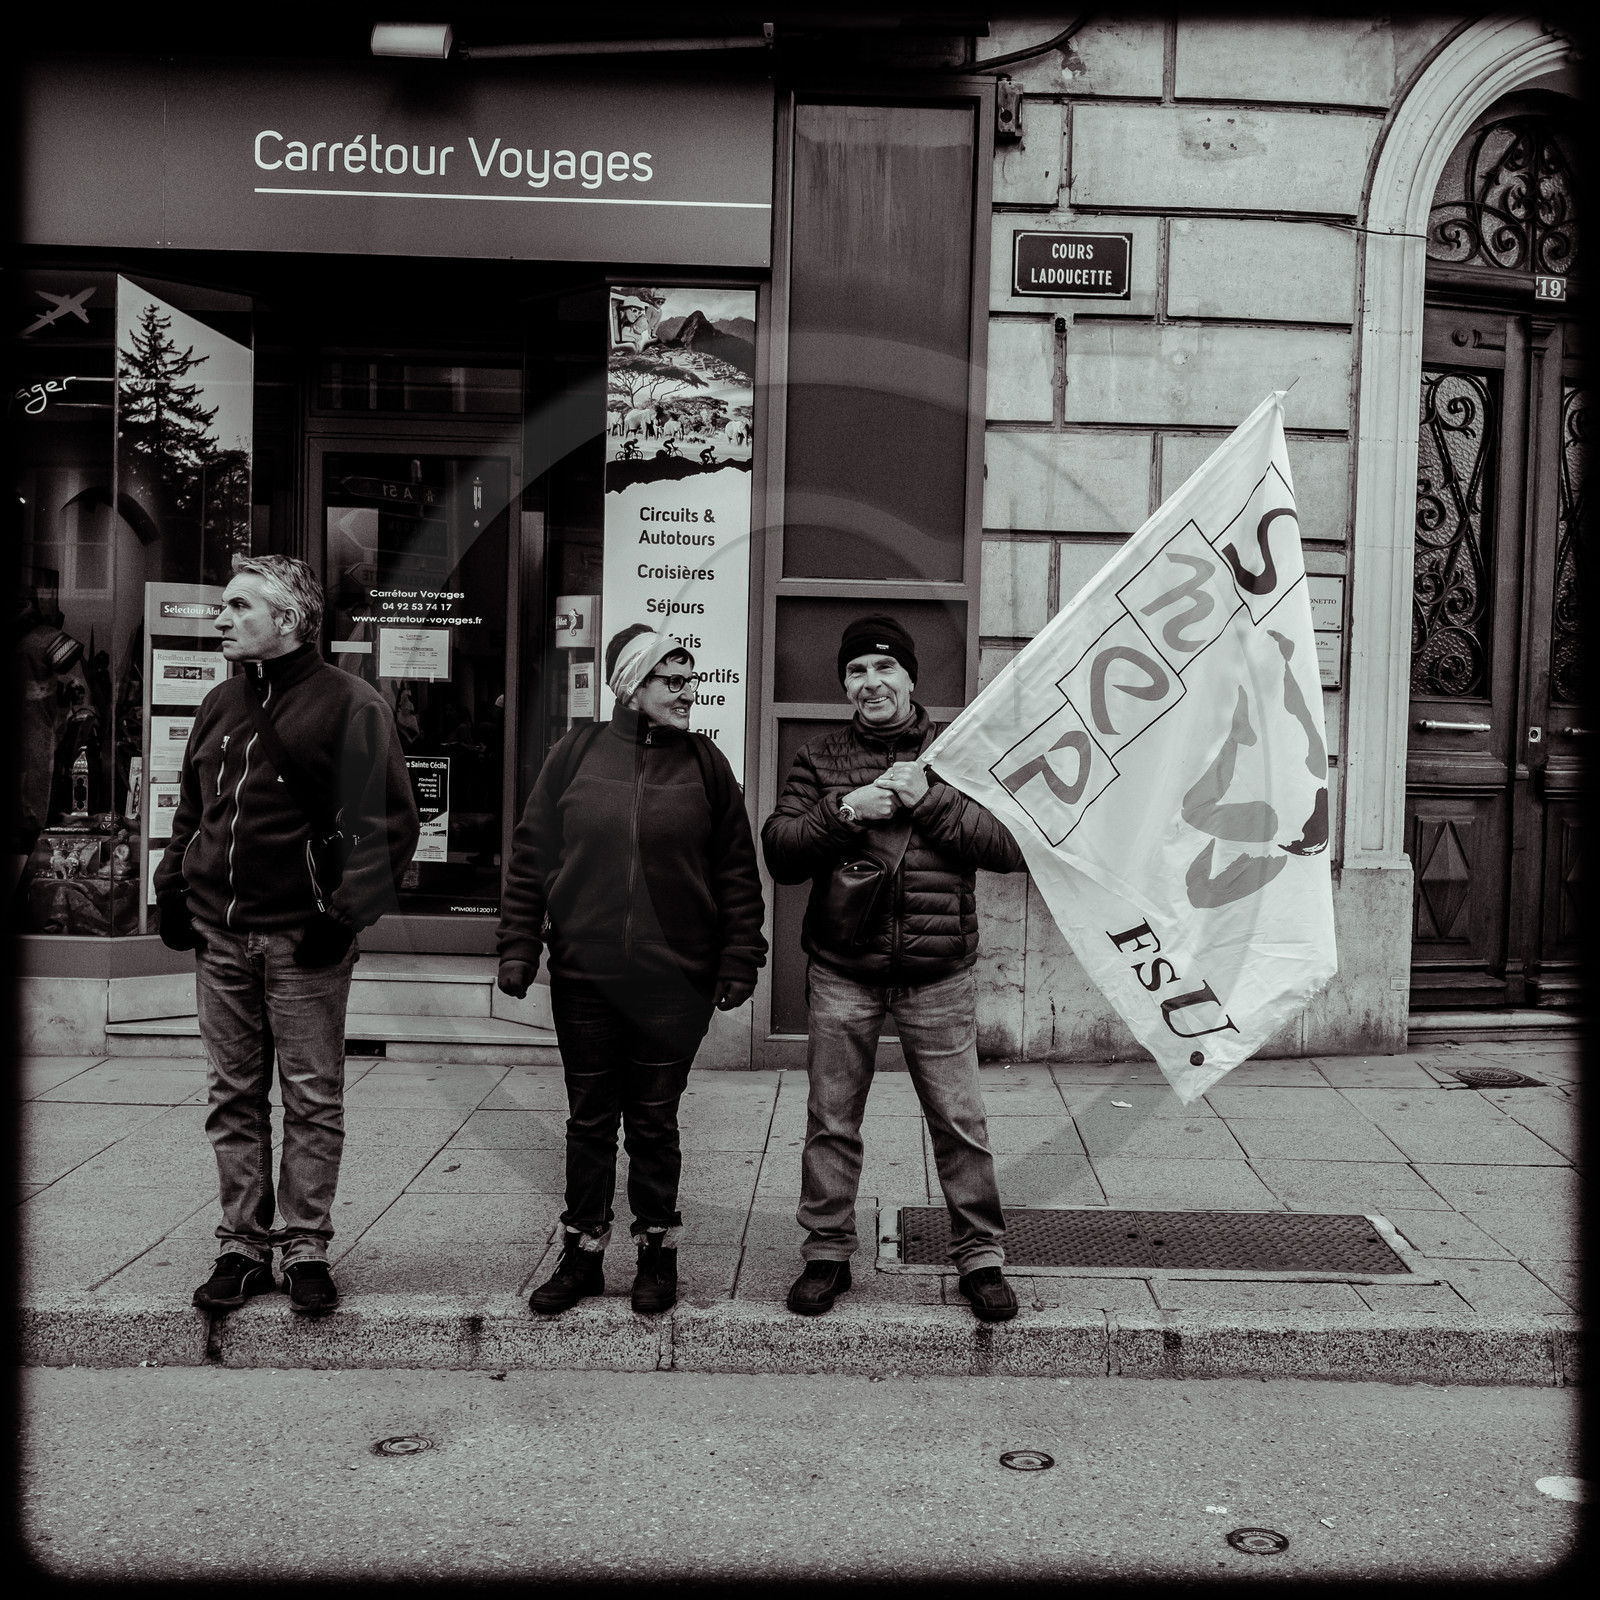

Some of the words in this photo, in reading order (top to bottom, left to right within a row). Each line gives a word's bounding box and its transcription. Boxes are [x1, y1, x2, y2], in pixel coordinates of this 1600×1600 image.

[254, 130, 454, 178] Carrétour
[469, 136, 654, 189] Voyages
[1052, 243, 1094, 260] COURS
[1031, 268, 1113, 286] LADOUCETTE
[1541, 279, 1562, 298] 19
[14, 375, 77, 415] ager
[639, 507, 699, 523] Circuits
[703, 509, 716, 523] &
[638, 530, 715, 546] Autotours
[637, 564, 715, 580] Croisières
[370, 588, 418, 599] Carrétour
[420, 590, 465, 601] Voyages
[164, 604, 205, 615] Selectour
[382, 602, 395, 611] 04
[397, 603, 409, 611] 92
[411, 603, 424, 611] 53
[426, 603, 438, 611] 74
[441, 603, 452, 611] 17
[646, 598, 705, 616] Séjours
[352, 615, 483, 626] www.carretour-voyages.fr
[669, 633, 702, 649] aris
[695, 691, 726, 706] ture
[411, 761, 430, 769] Sainte
[430, 761, 447, 769] Cécile
